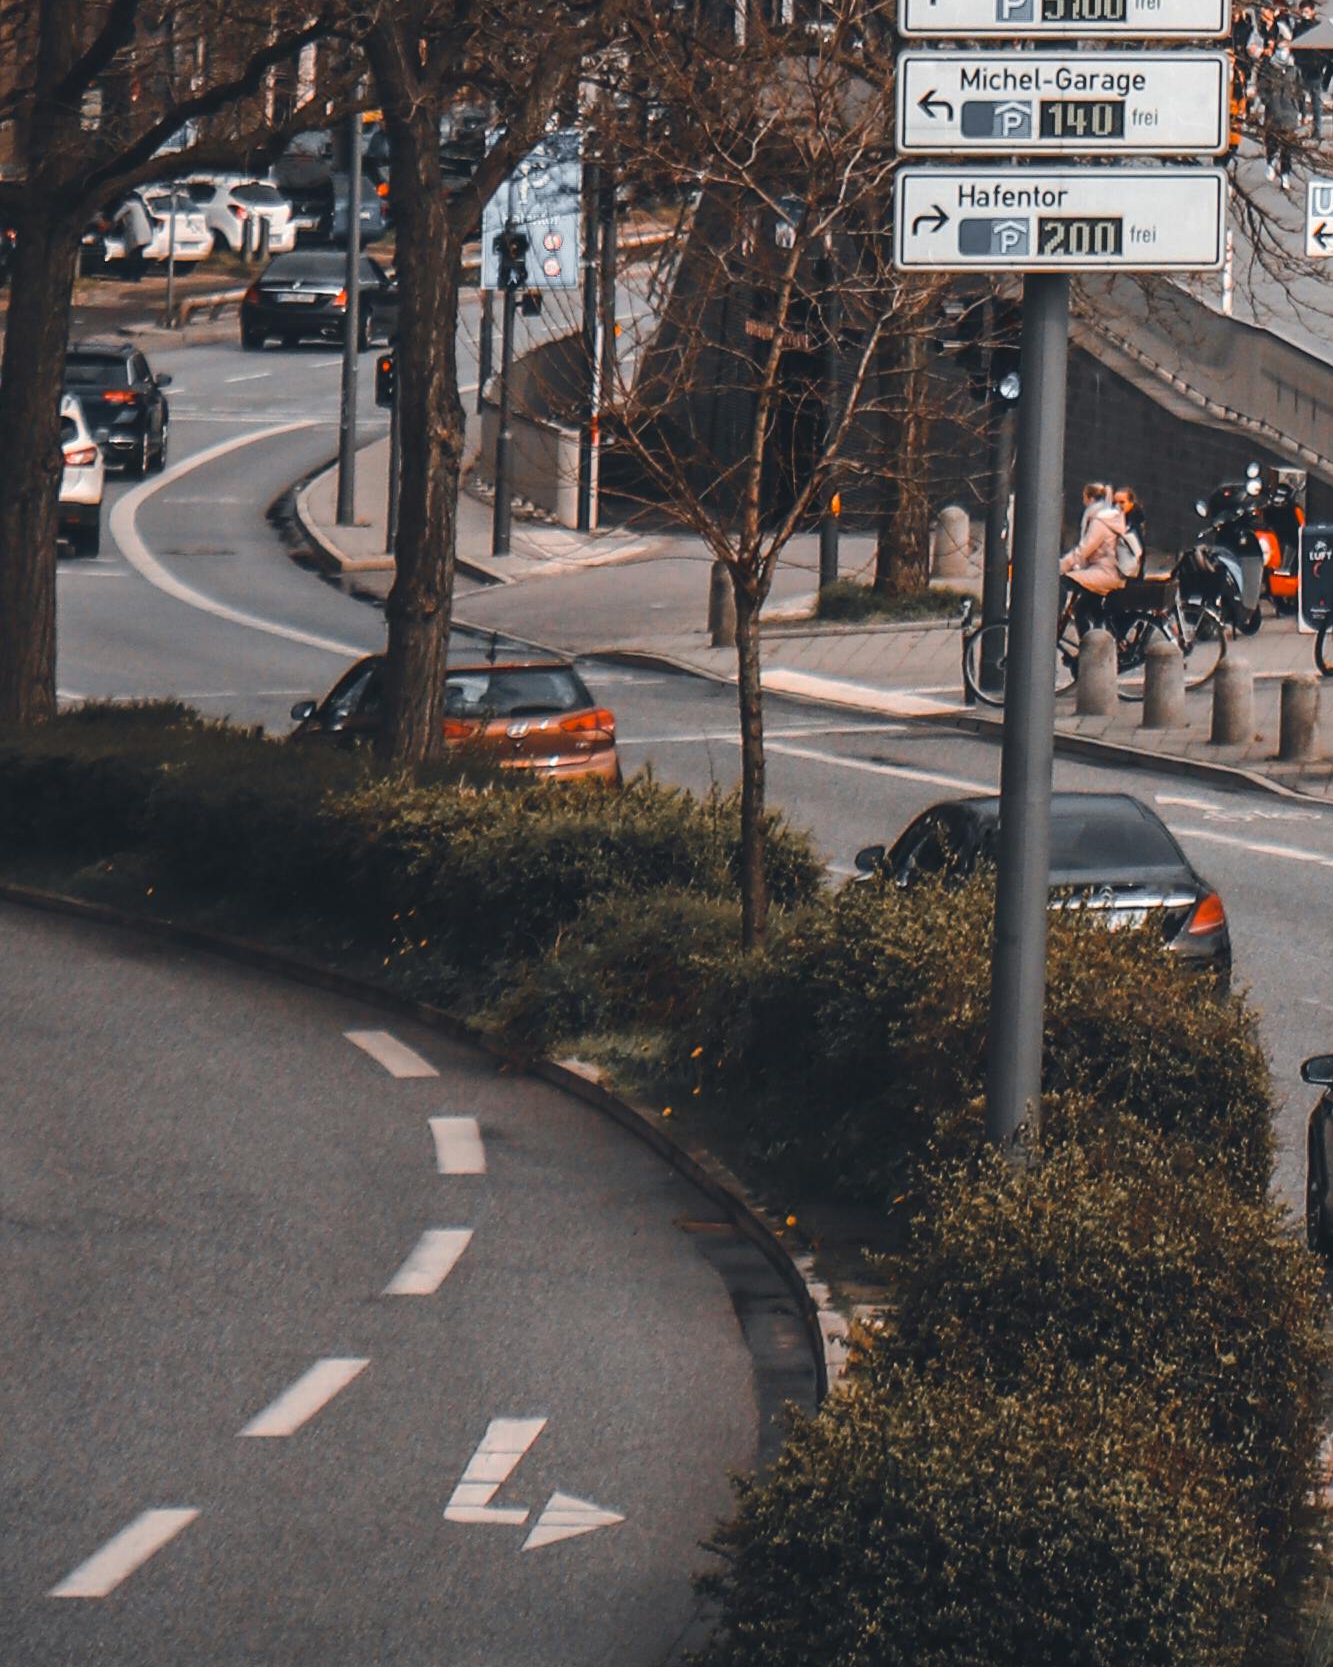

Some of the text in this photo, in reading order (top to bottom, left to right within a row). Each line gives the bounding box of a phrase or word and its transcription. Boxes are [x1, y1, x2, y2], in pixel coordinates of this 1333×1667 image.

[960, 68, 1146, 96] Michel-Garage
[1003, 103, 1159, 137] P 140 frei
[958, 184, 1068, 208] Hafentor
[1002, 222, 1157, 256] P 200 frei
